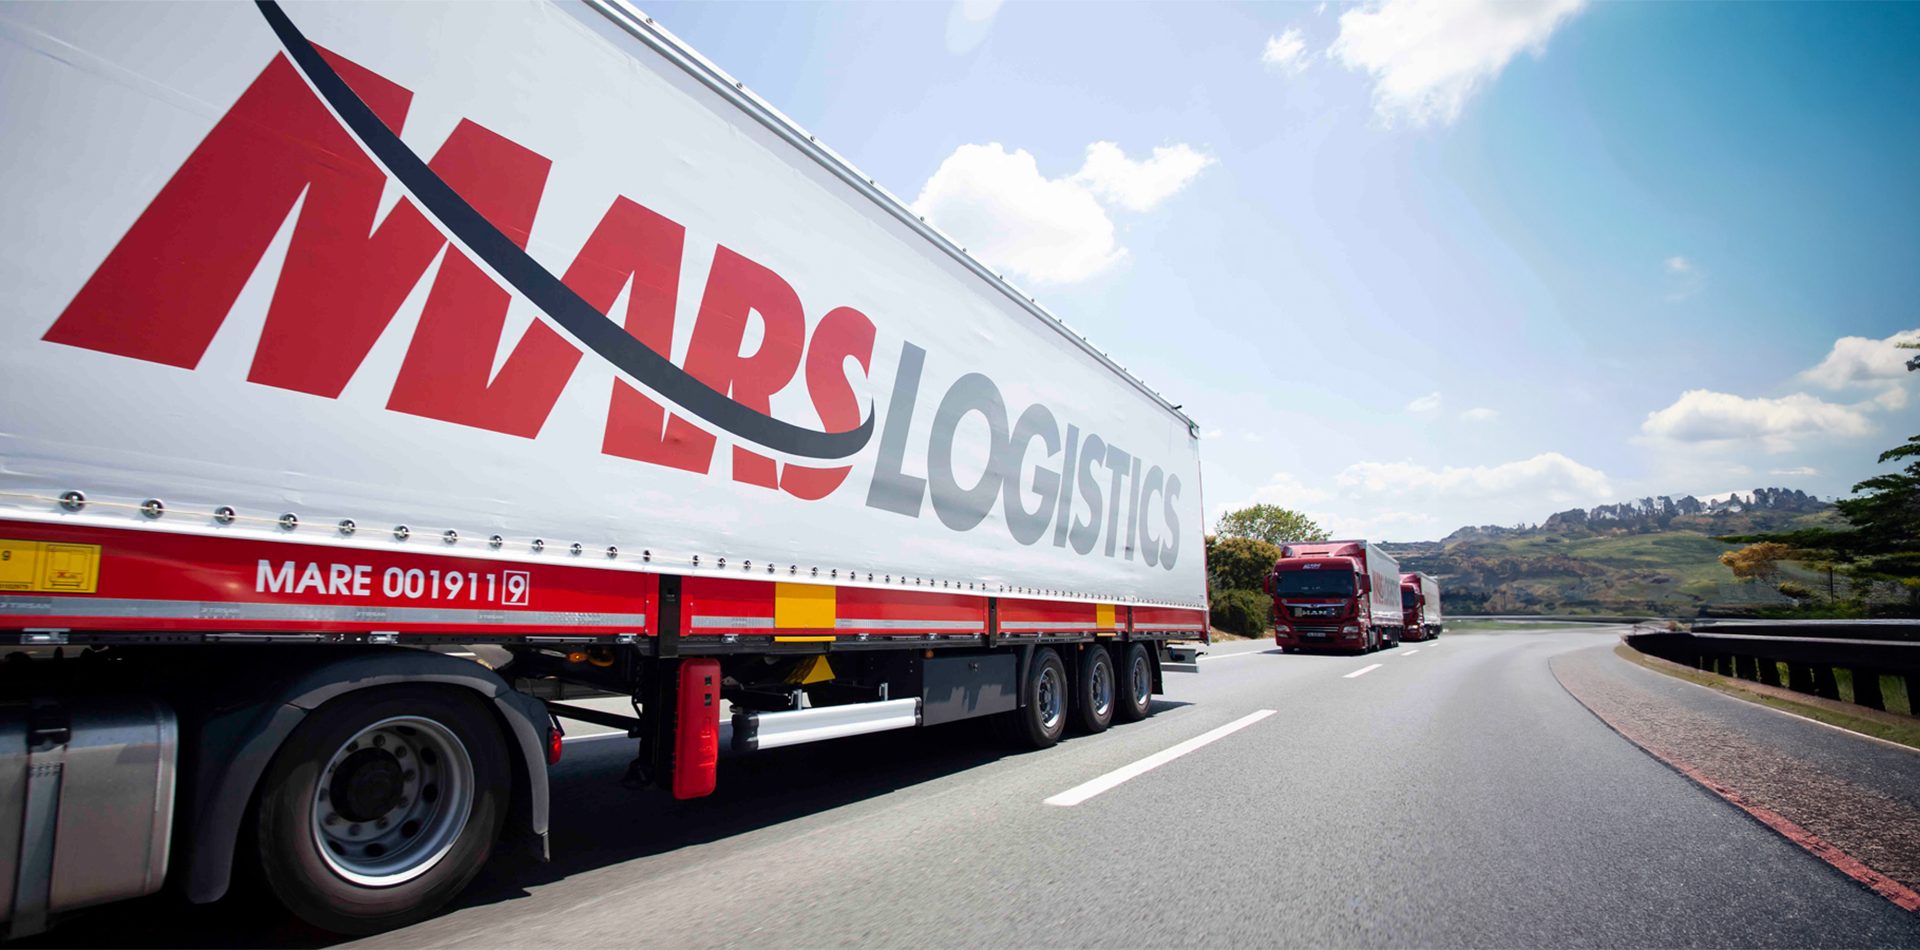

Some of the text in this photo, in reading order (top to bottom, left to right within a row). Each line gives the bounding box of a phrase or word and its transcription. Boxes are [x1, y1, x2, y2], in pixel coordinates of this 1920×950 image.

[42, 42, 1182, 571] MARS LOGISTICS
[255, 559, 373, 596] MARE
